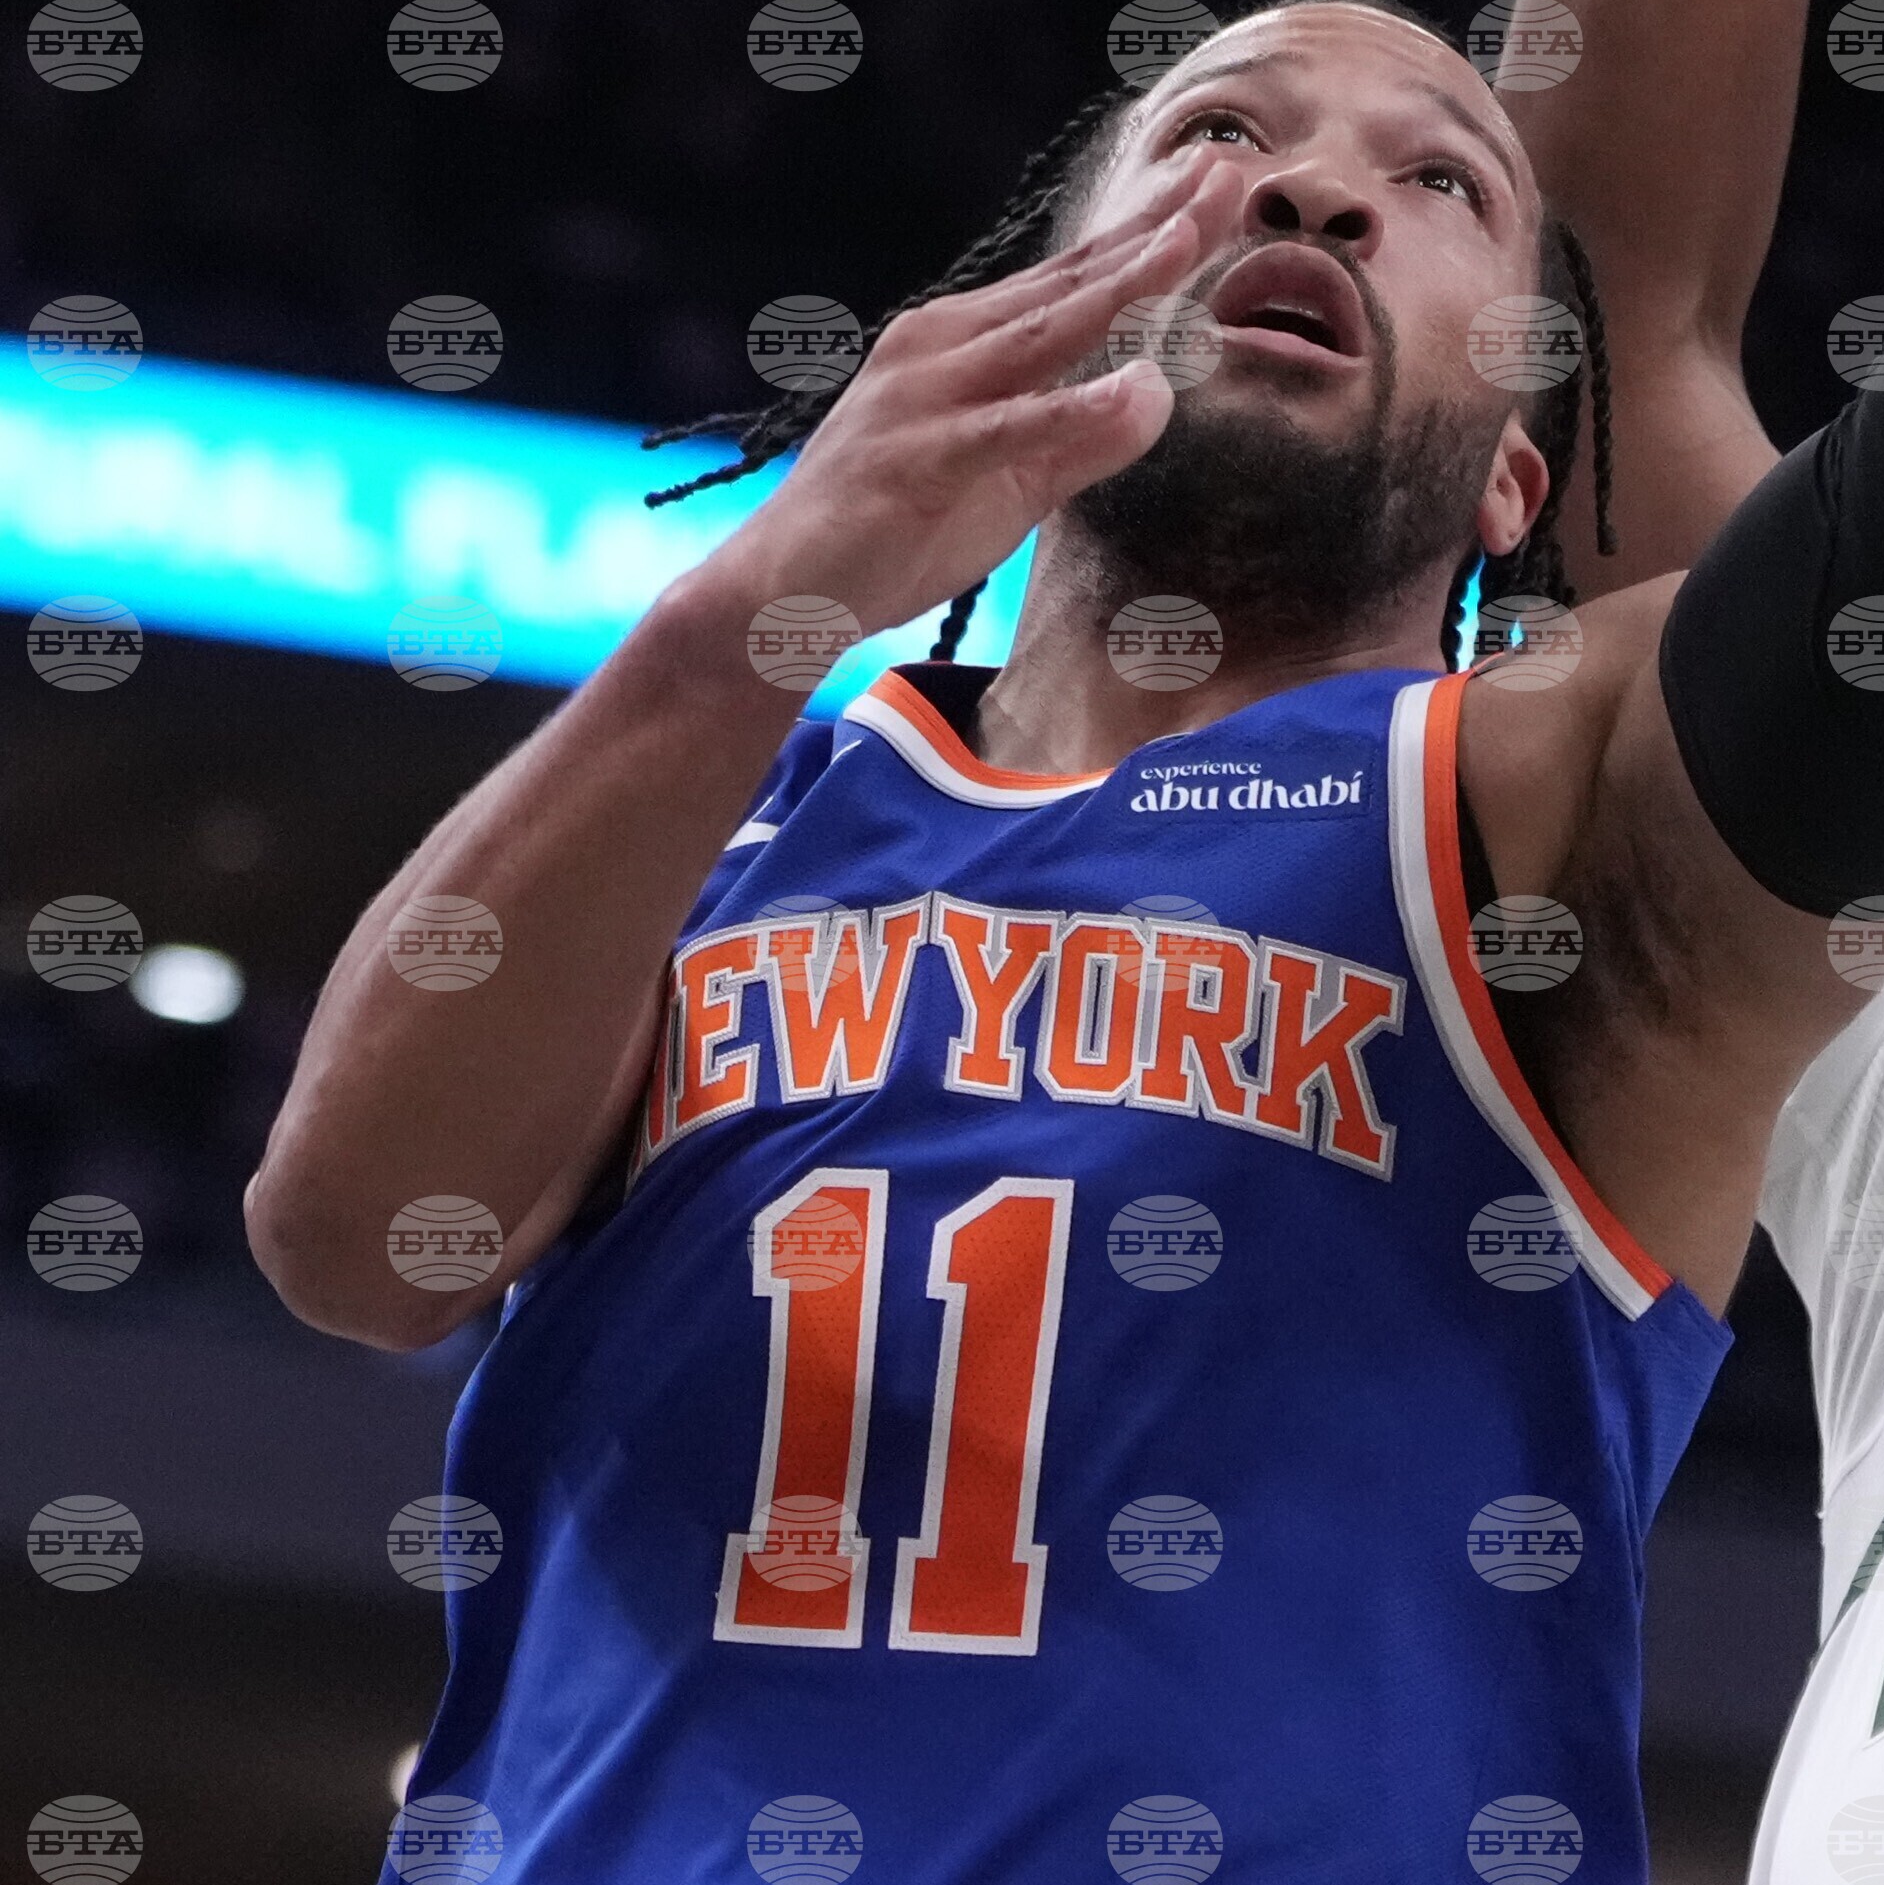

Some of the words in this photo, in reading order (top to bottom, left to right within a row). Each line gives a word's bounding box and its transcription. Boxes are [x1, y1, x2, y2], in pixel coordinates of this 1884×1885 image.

[1130, 781, 1219, 813] abu
[928, 891, 1406, 1182] YORK
[714, 1166, 1074, 1656] 11
